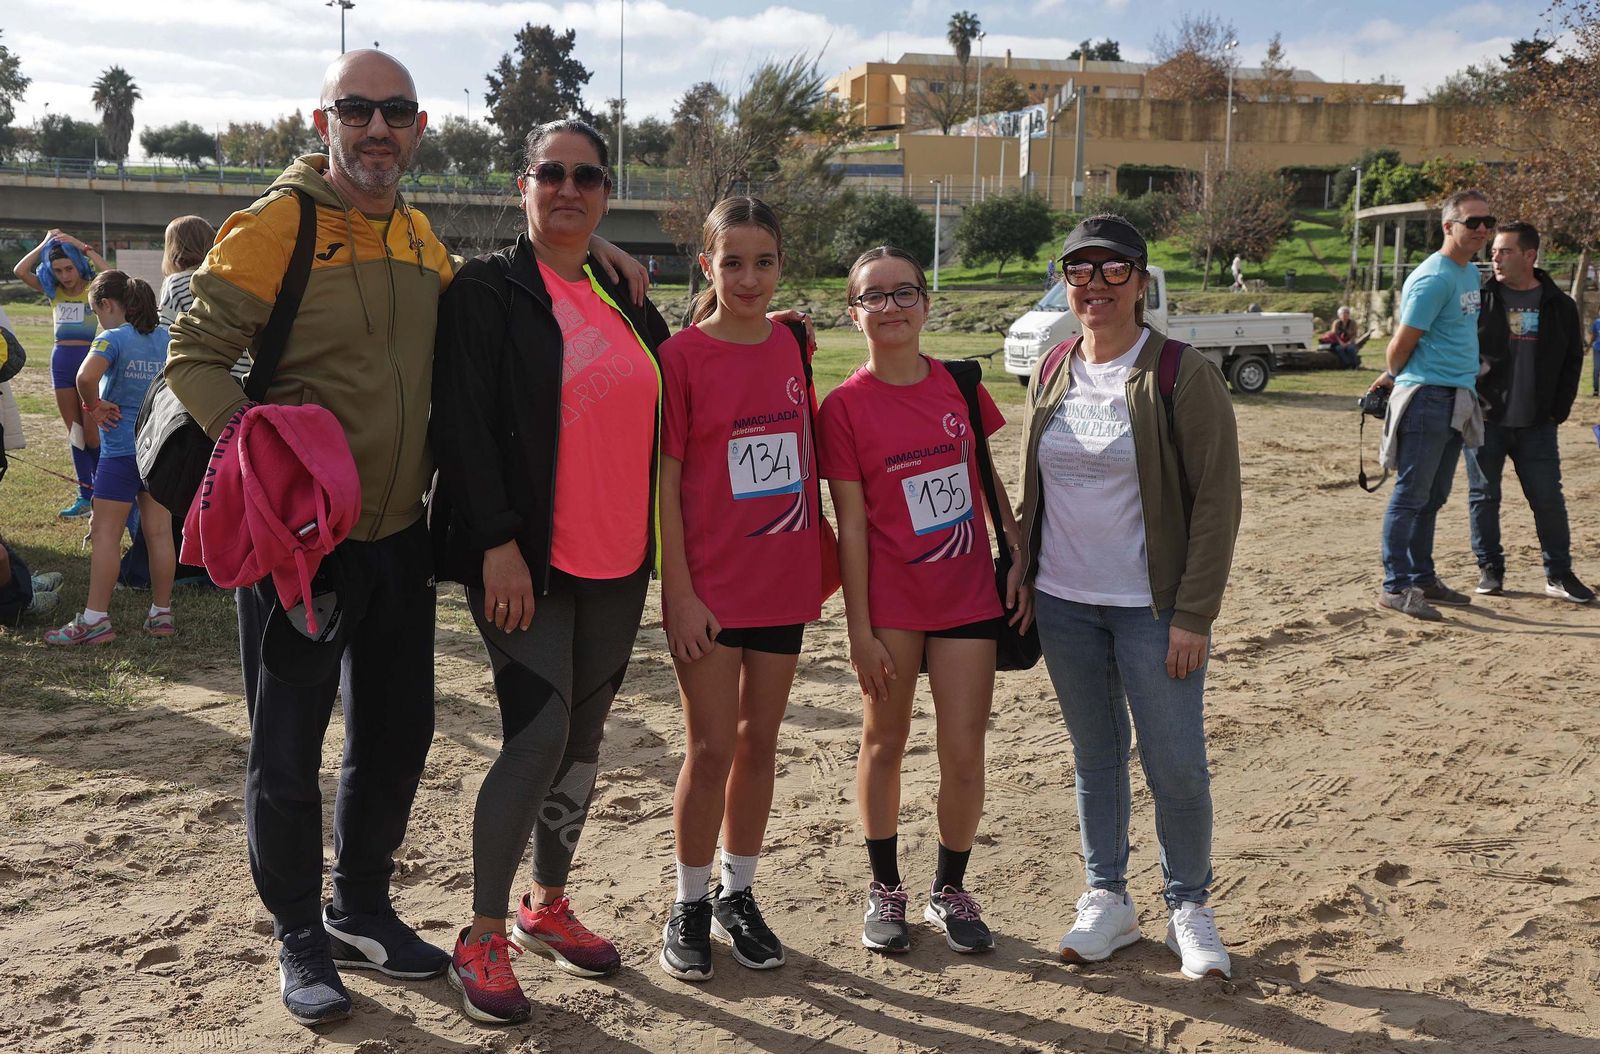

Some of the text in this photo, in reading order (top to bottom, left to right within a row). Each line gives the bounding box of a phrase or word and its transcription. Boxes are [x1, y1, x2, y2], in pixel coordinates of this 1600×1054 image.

[59, 306, 79, 320] 221
[731, 425, 767, 437] atletismo
[738, 438, 791, 484] 134
[884, 443, 956, 467] INMACULADA
[885, 459, 922, 473] atletismo
[918, 472, 966, 518] 135
